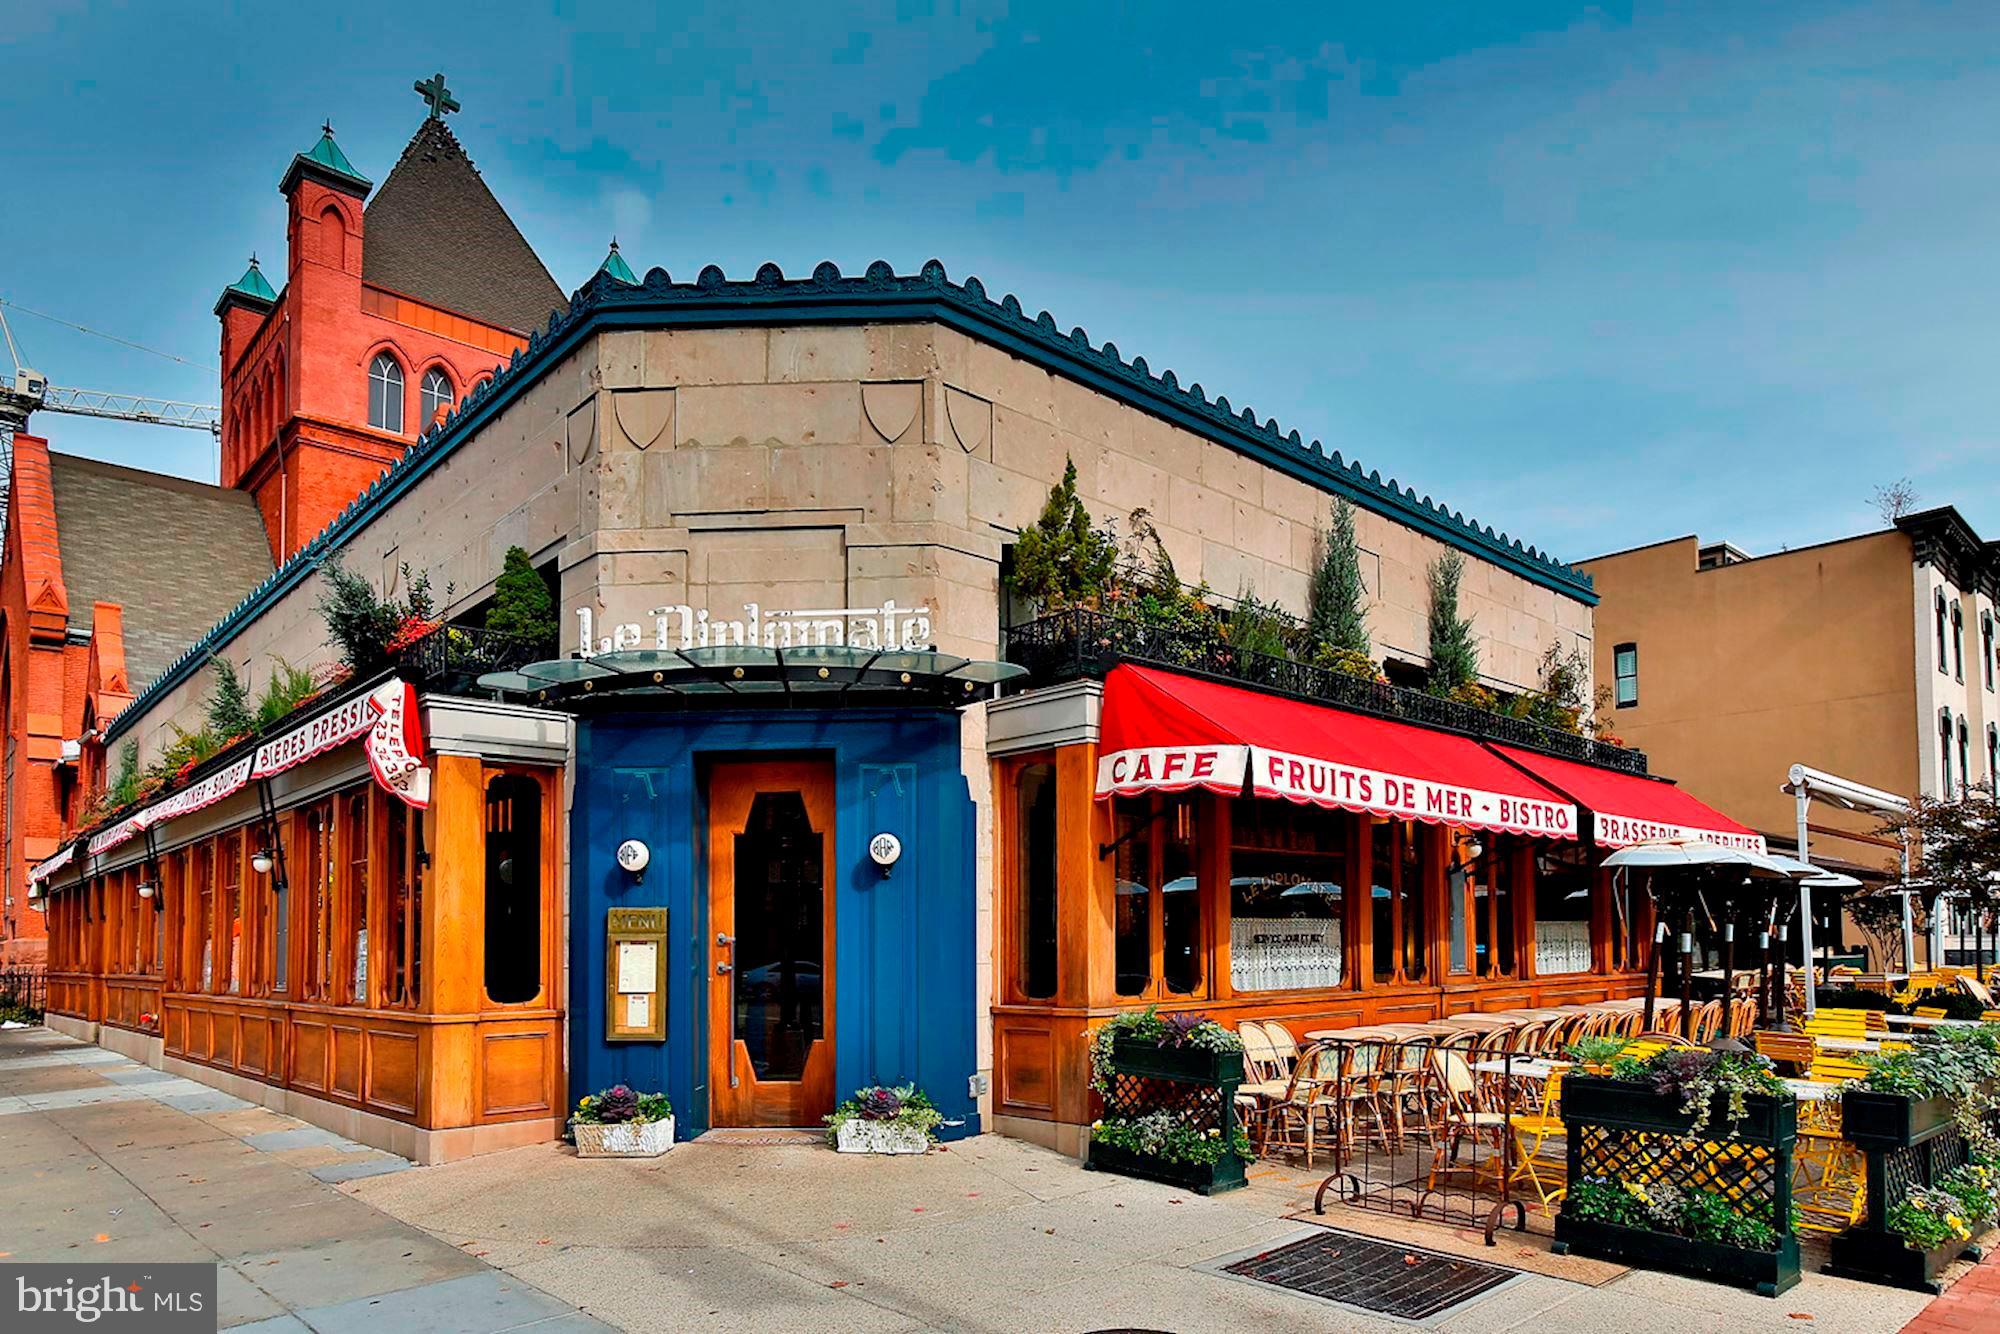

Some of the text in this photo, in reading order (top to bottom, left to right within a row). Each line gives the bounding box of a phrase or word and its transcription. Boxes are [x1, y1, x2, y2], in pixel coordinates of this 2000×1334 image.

[575, 606, 642, 659] Le
[260, 731, 306, 768] BIERES
[1112, 751, 1218, 784] CAFE
[1268, 755, 1372, 802] FRUITS
[1384, 778, 1415, 809] DE
[1426, 786, 1472, 817] MER
[1500, 798, 1568, 829] BISTRO
[613, 913, 662, 929] MENU
